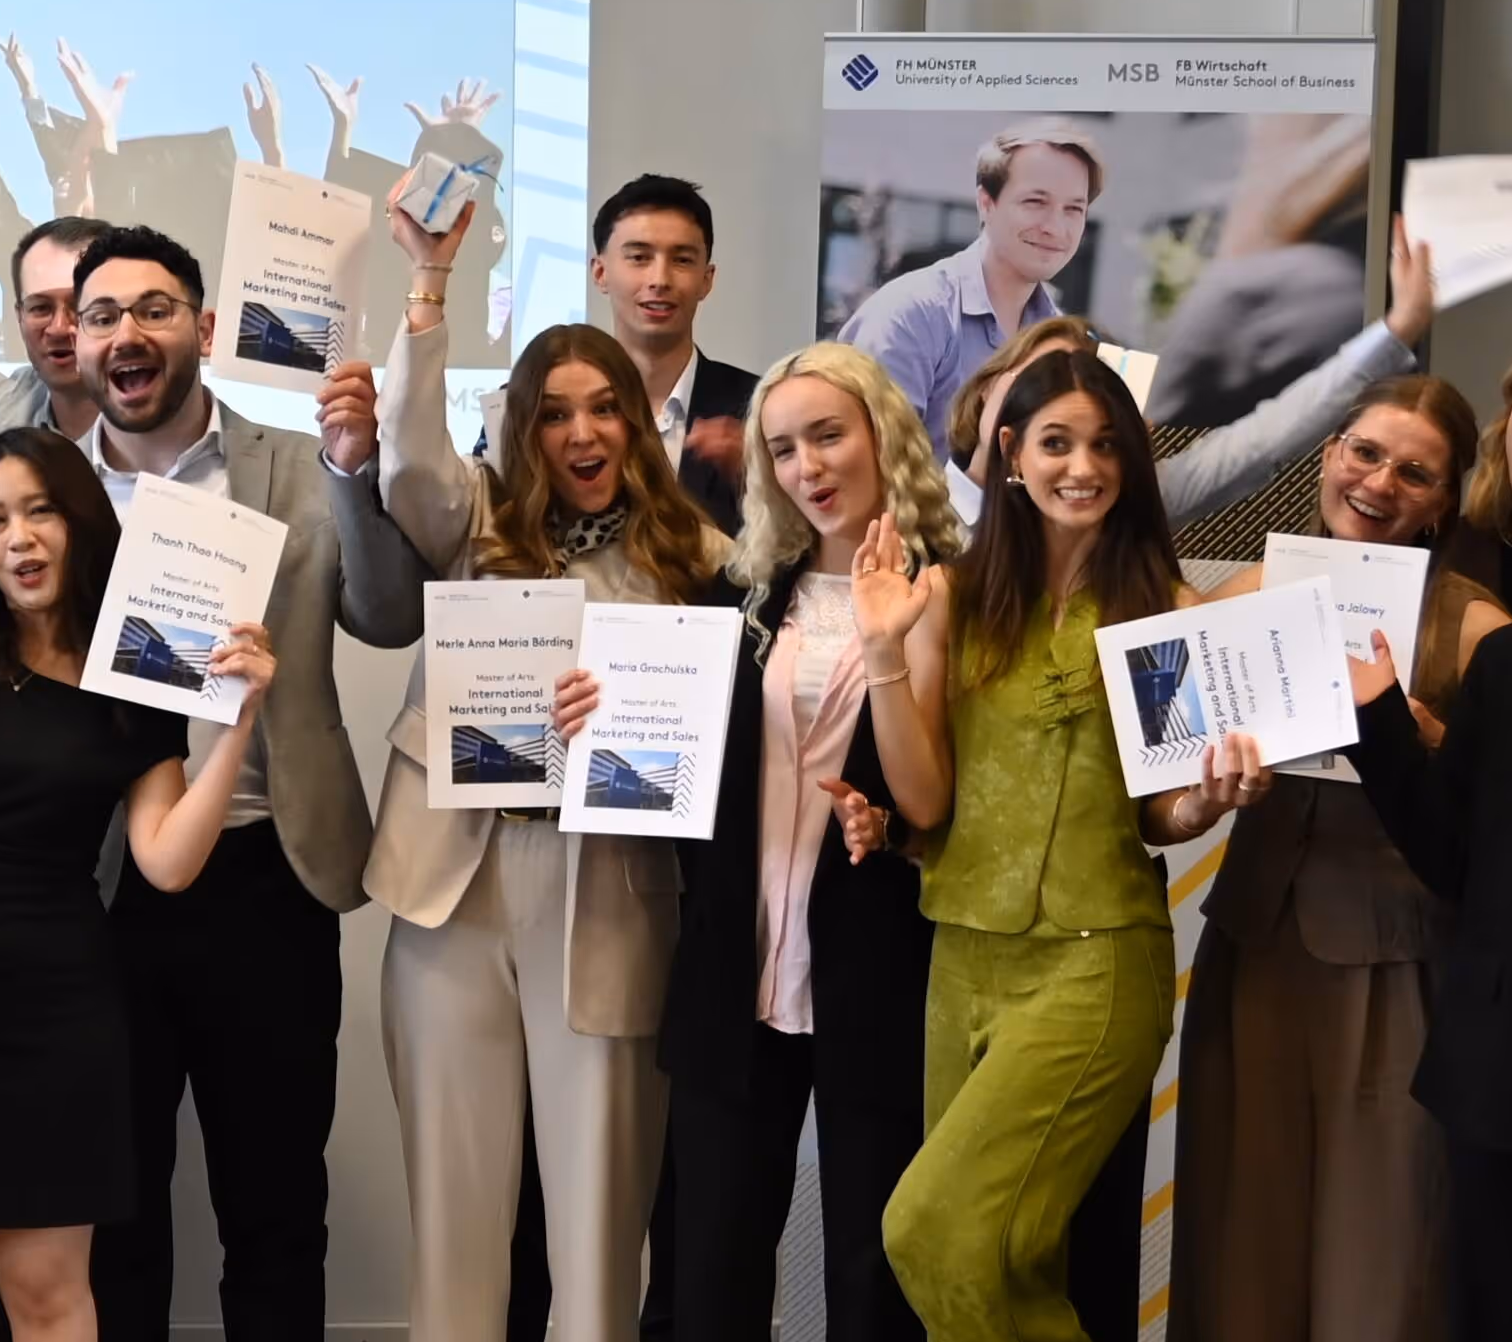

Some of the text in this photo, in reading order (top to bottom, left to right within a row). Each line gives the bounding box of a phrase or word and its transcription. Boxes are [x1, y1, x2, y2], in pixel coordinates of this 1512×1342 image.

[896, 58, 977, 71] FH MÜNSTER
[1176, 60, 1267, 72] FB Wirtschaft
[1107, 63, 1160, 83] MSB
[895, 74, 1078, 88] University of Applied Sciences
[1175, 75, 1356, 89] Münster School of Business
[268, 220, 336, 247] Mahdi Ammar
[263, 269, 332, 293] International
[242, 280, 347, 313] Marketing and Sales
[151, 532, 248, 574] Thanh Thao Hoang
[150, 584, 225, 612] International
[127, 594, 234, 630] Marketing and Sale
[436, 635, 574, 650] Merle Anna Maria Börding
[608, 662, 698, 675] Maria Grochulska
[1197, 630, 1217, 692] Marketing
[1210, 693, 1224, 716] and
[1238, 651, 1250, 683] Master
[1269, 629, 1297, 719] Arianna Martini
[475, 673, 505, 682] Master
[517, 673, 535, 682] Arts
[468, 687, 543, 700] International
[1217, 646, 1245, 727] International
[449, 703, 552, 717] Marketing and Sal
[620, 698, 648, 707] Master
[611, 713, 683, 726] International
[591, 728, 699, 742] Marketing and Sales
